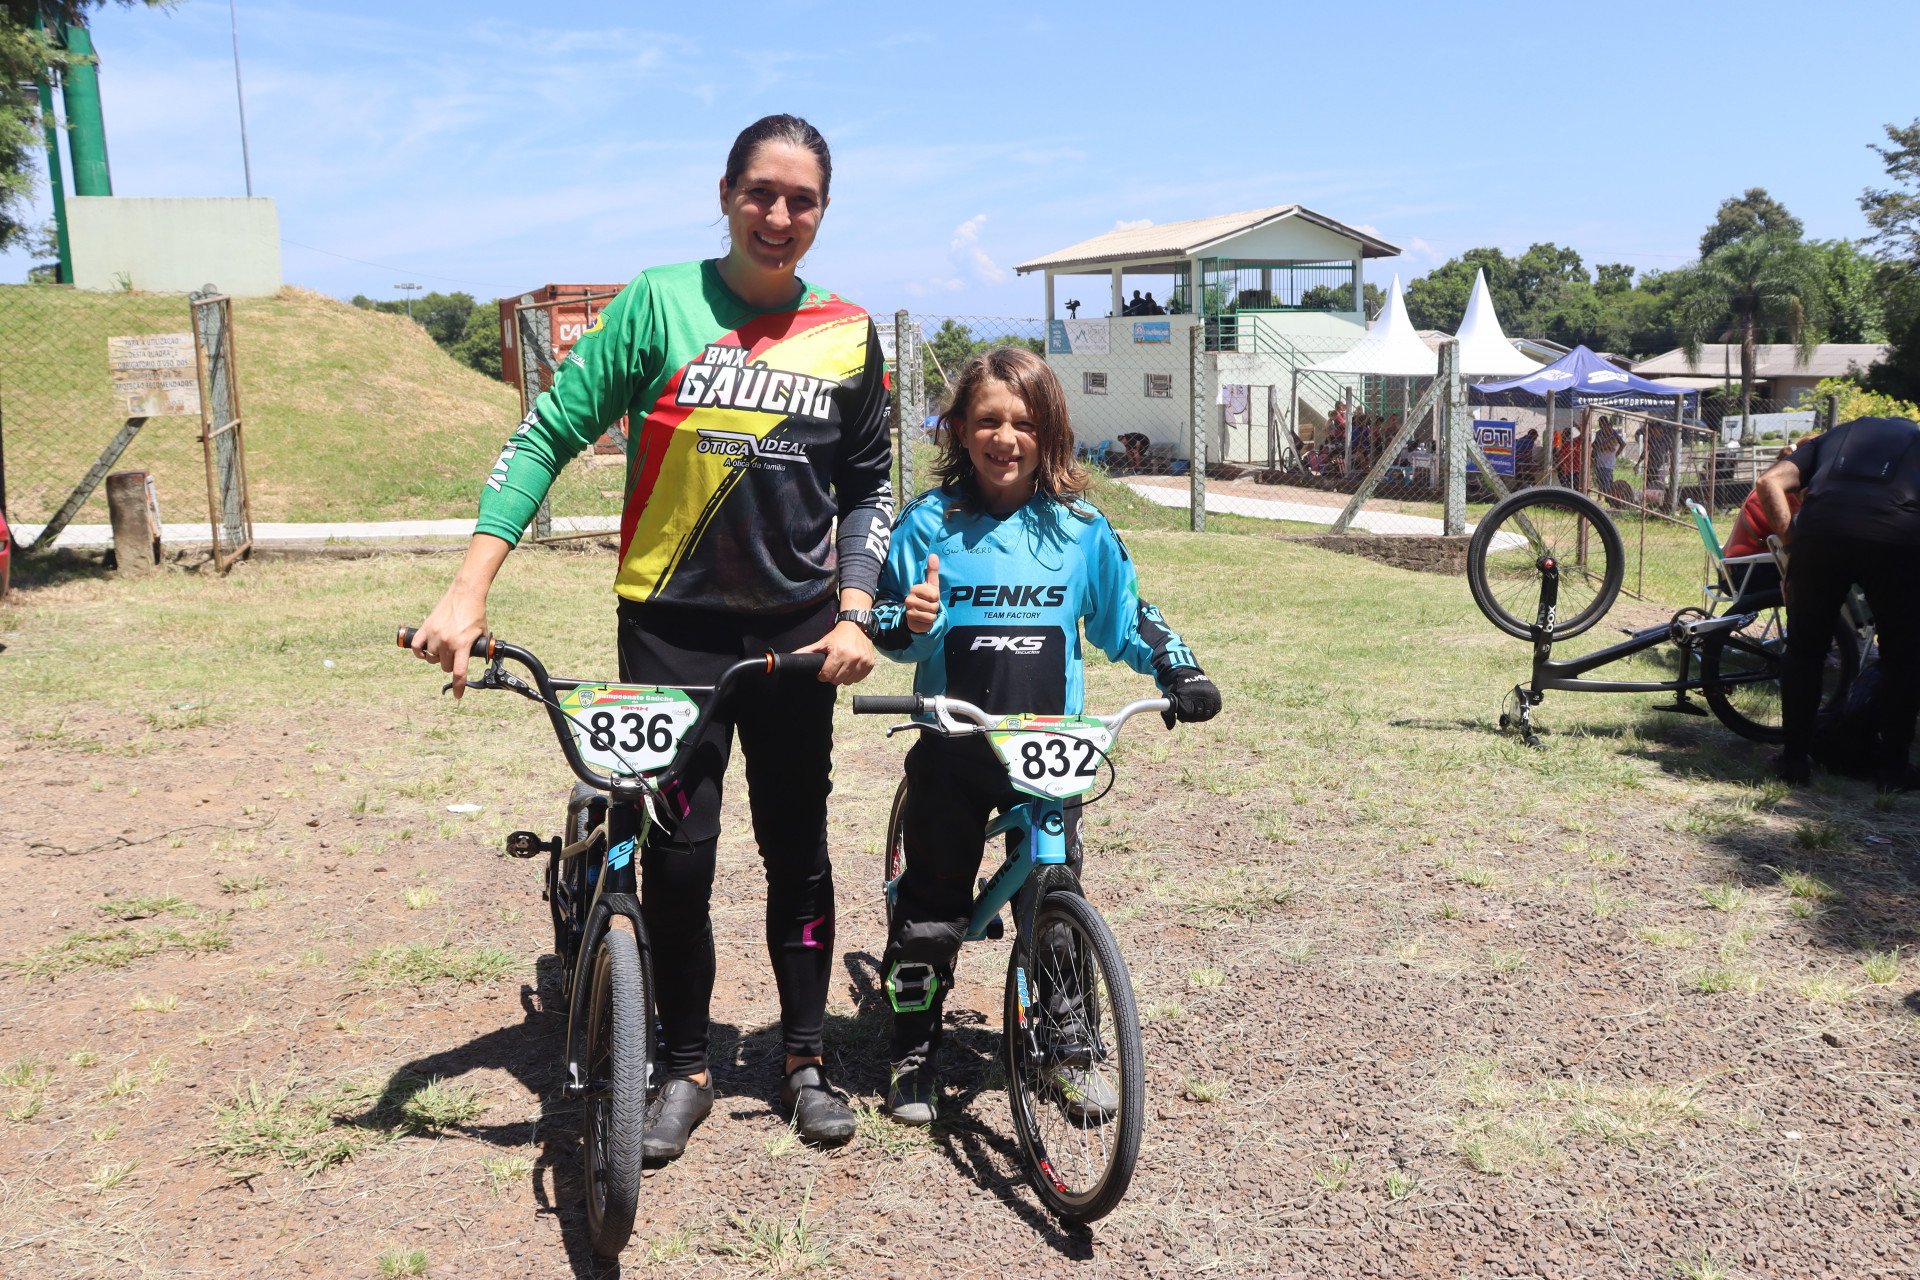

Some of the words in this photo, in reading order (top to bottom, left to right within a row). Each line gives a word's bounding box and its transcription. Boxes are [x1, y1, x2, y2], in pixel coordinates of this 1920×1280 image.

[704, 346, 750, 367] BMX
[678, 362, 841, 420] GAÚCHO
[697, 437, 749, 455] ÓTICA
[724, 459, 731, 467] A
[751, 460, 762, 469] da
[948, 585, 1068, 608] PENKS
[983, 611, 1005, 619] TEAM
[1006, 611, 1042, 619] FACTORY
[970, 635, 1046, 651] PKS
[590, 711, 674, 753] 836
[1021, 739, 1097, 780] 832
